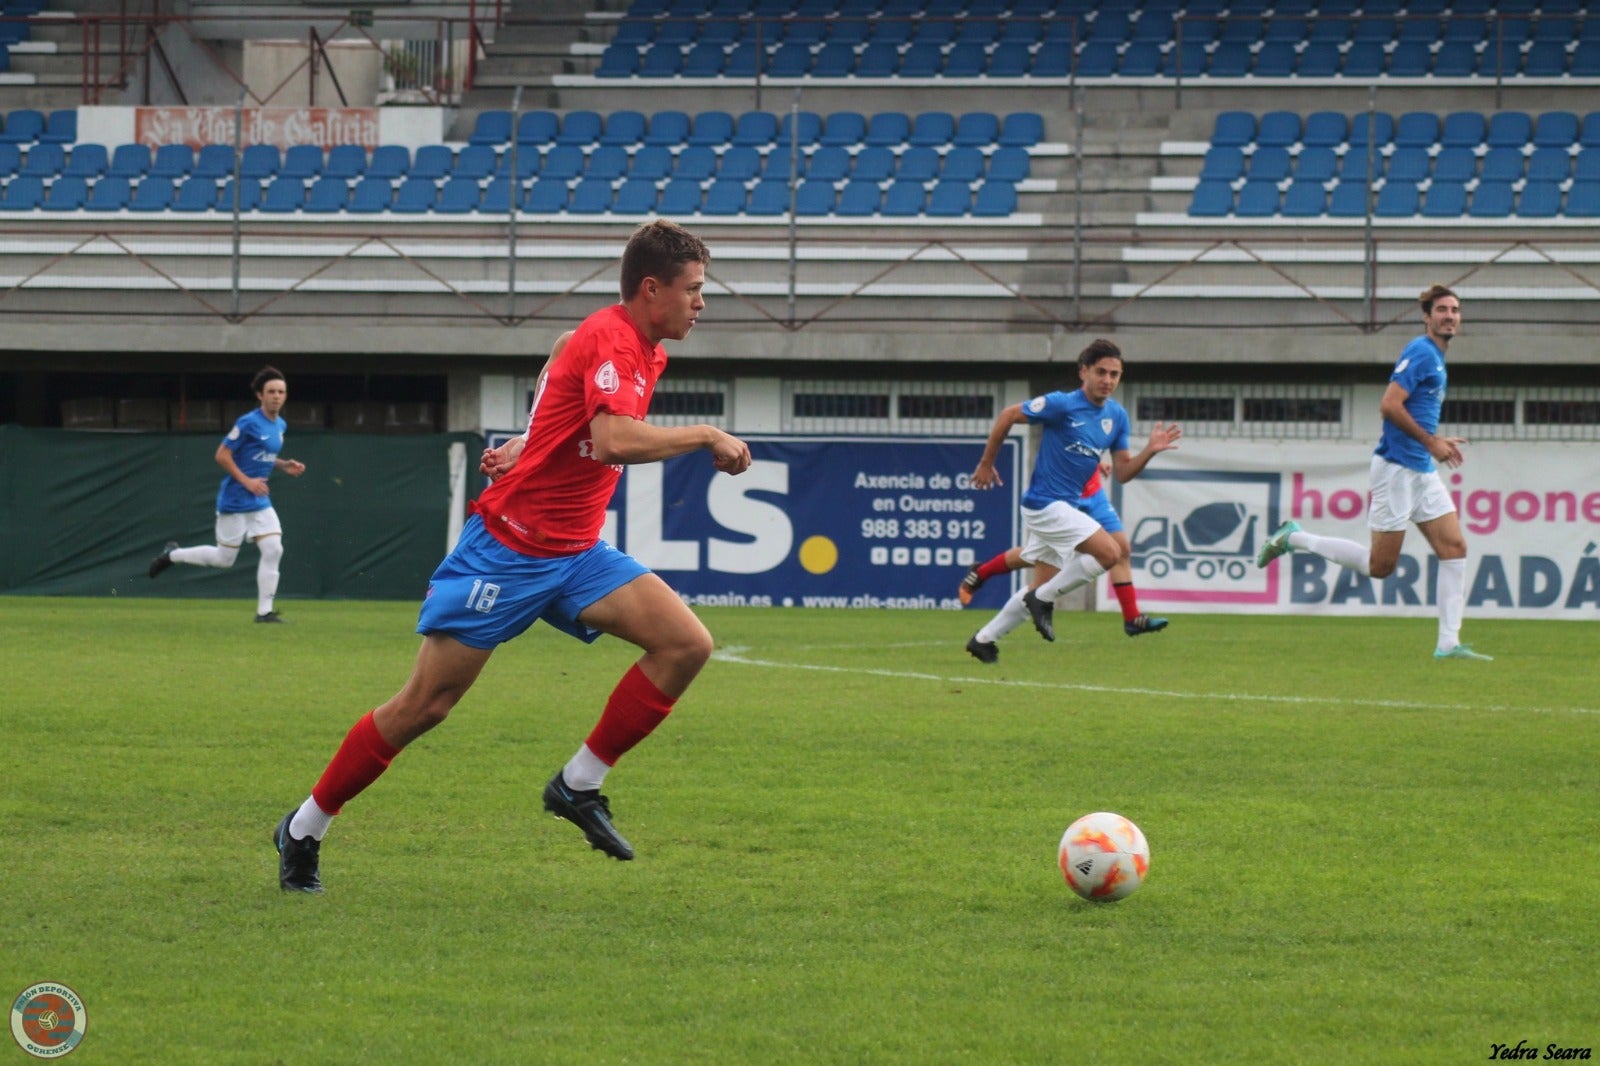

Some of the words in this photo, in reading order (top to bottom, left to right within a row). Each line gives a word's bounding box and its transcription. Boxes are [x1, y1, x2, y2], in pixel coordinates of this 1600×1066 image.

[250, 109, 277, 146] de
[284, 108, 379, 146] Galicia
[854, 471, 925, 489] Axencia
[929, 473, 951, 489] de
[872, 498, 895, 511] en
[900, 495, 975, 512] Ourense
[1291, 472, 1600, 536] hoigone
[861, 518, 899, 538] 988
[904, 519, 942, 539] 383
[947, 520, 985, 539] 912
[1289, 541, 1600, 610] BARADÁ
[465, 578, 501, 613] 18
